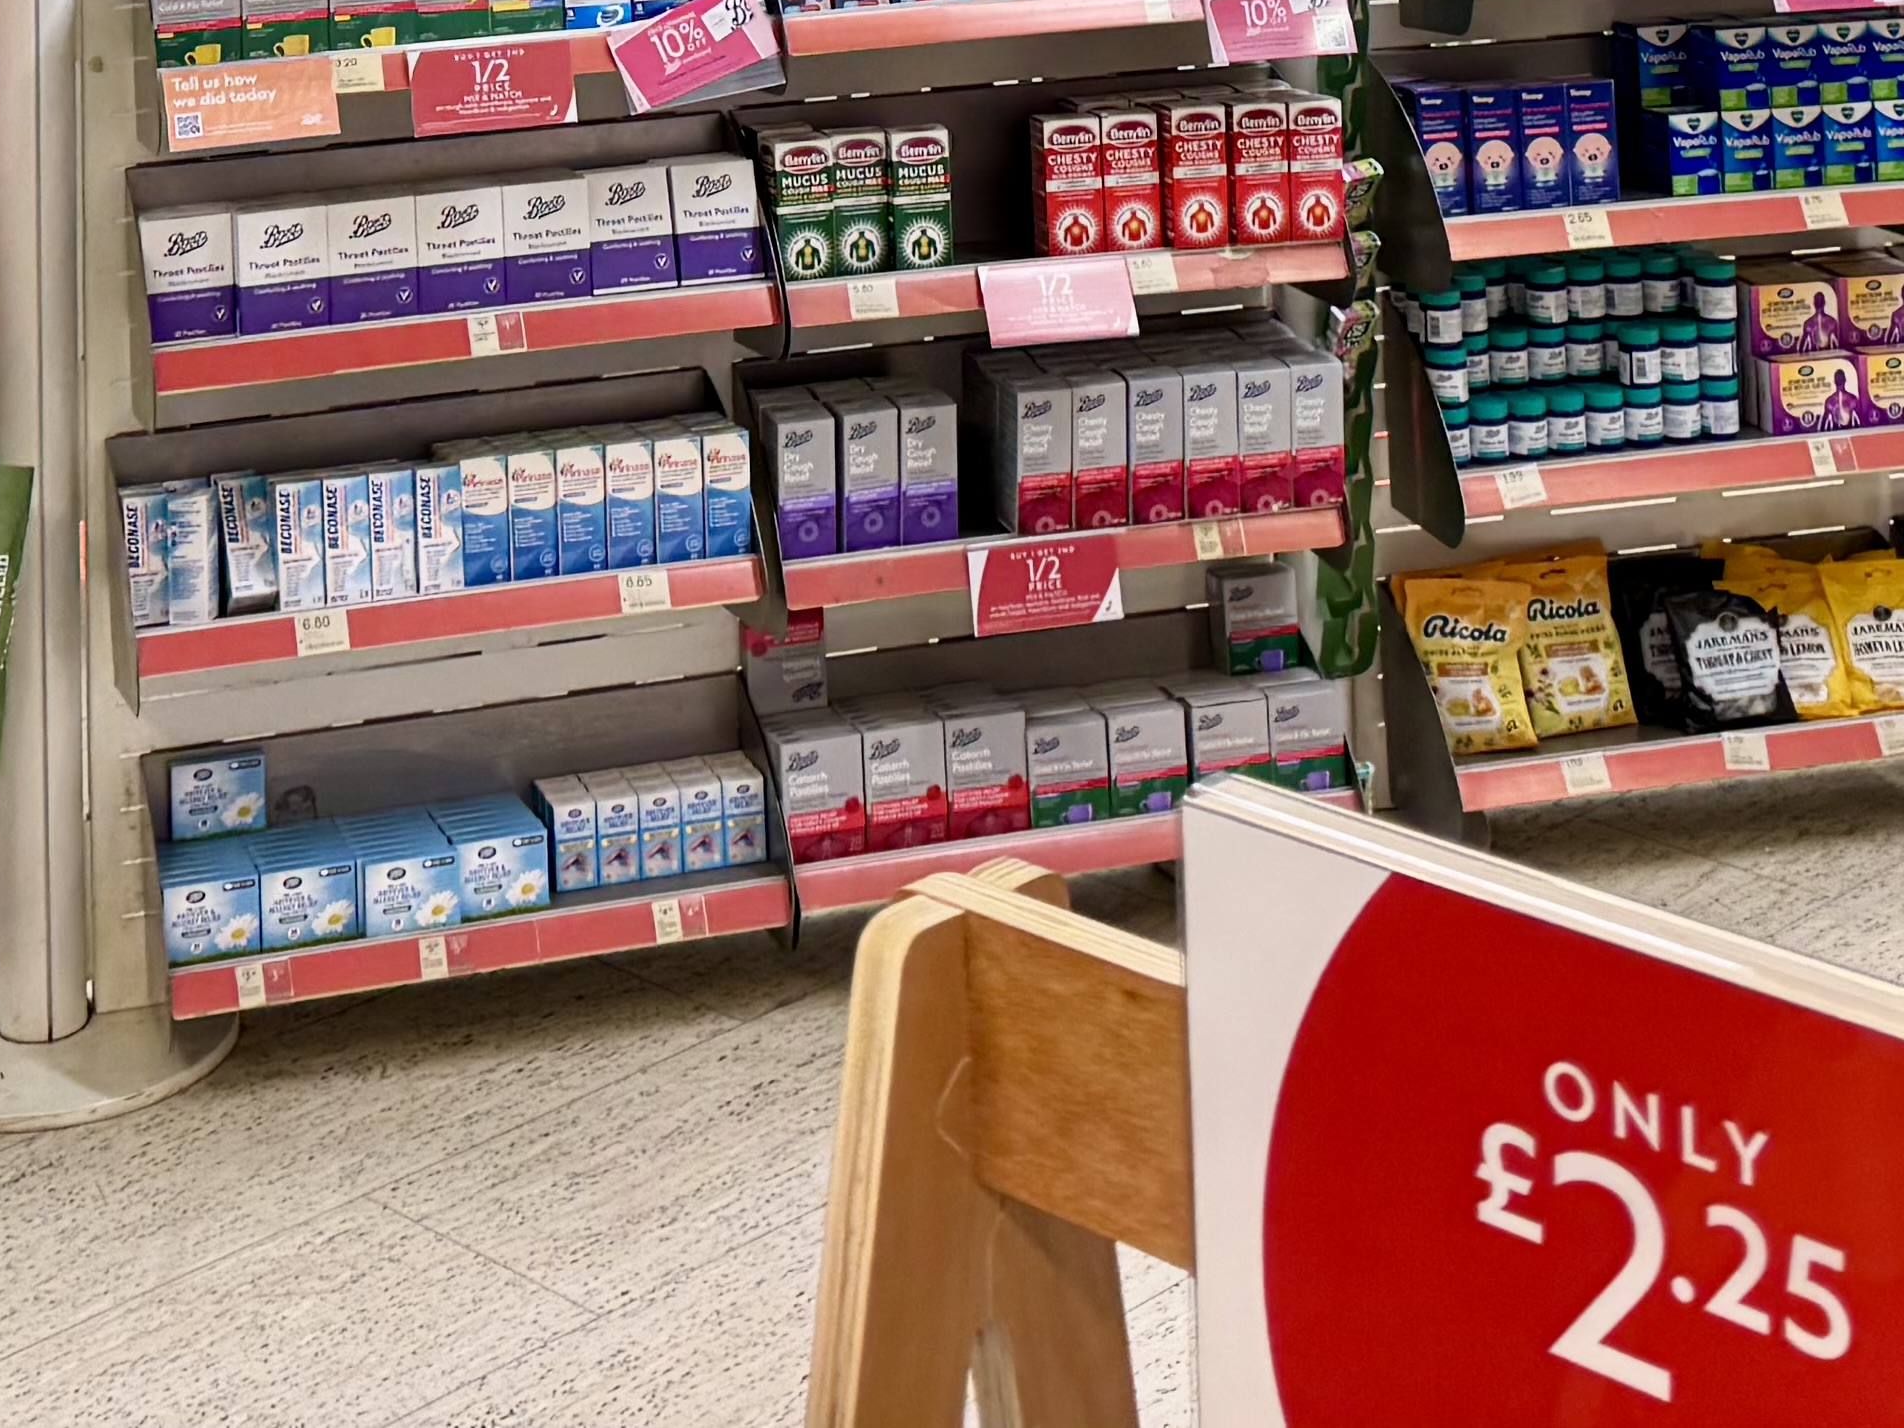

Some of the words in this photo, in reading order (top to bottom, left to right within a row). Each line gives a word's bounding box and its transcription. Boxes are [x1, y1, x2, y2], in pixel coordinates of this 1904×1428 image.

[650, 19, 703, 65] 10%
[471, 60, 509, 83] 1/2
[172, 76, 198, 93] Tell
[203, 78, 220, 89] us
[225, 74, 257, 89] how
[173, 94, 196, 108] we
[200, 89, 226, 105] did
[230, 88, 276, 104] today
[1106, 148, 1155, 161] CHESTY
[692, 174, 732, 198] Boots
[782, 174, 828, 187] MUCUS
[683, 207, 711, 218] Throat
[281, 491, 293, 554] BECONASE
[1026, 557, 1061, 581] 1/2
[1029, 580, 1061, 591] PRICE
[1424, 614, 1506, 643] Ricola
[1542, 1061, 1768, 1185] ONLY
[1475, 1122, 1853, 1402] £2.25
